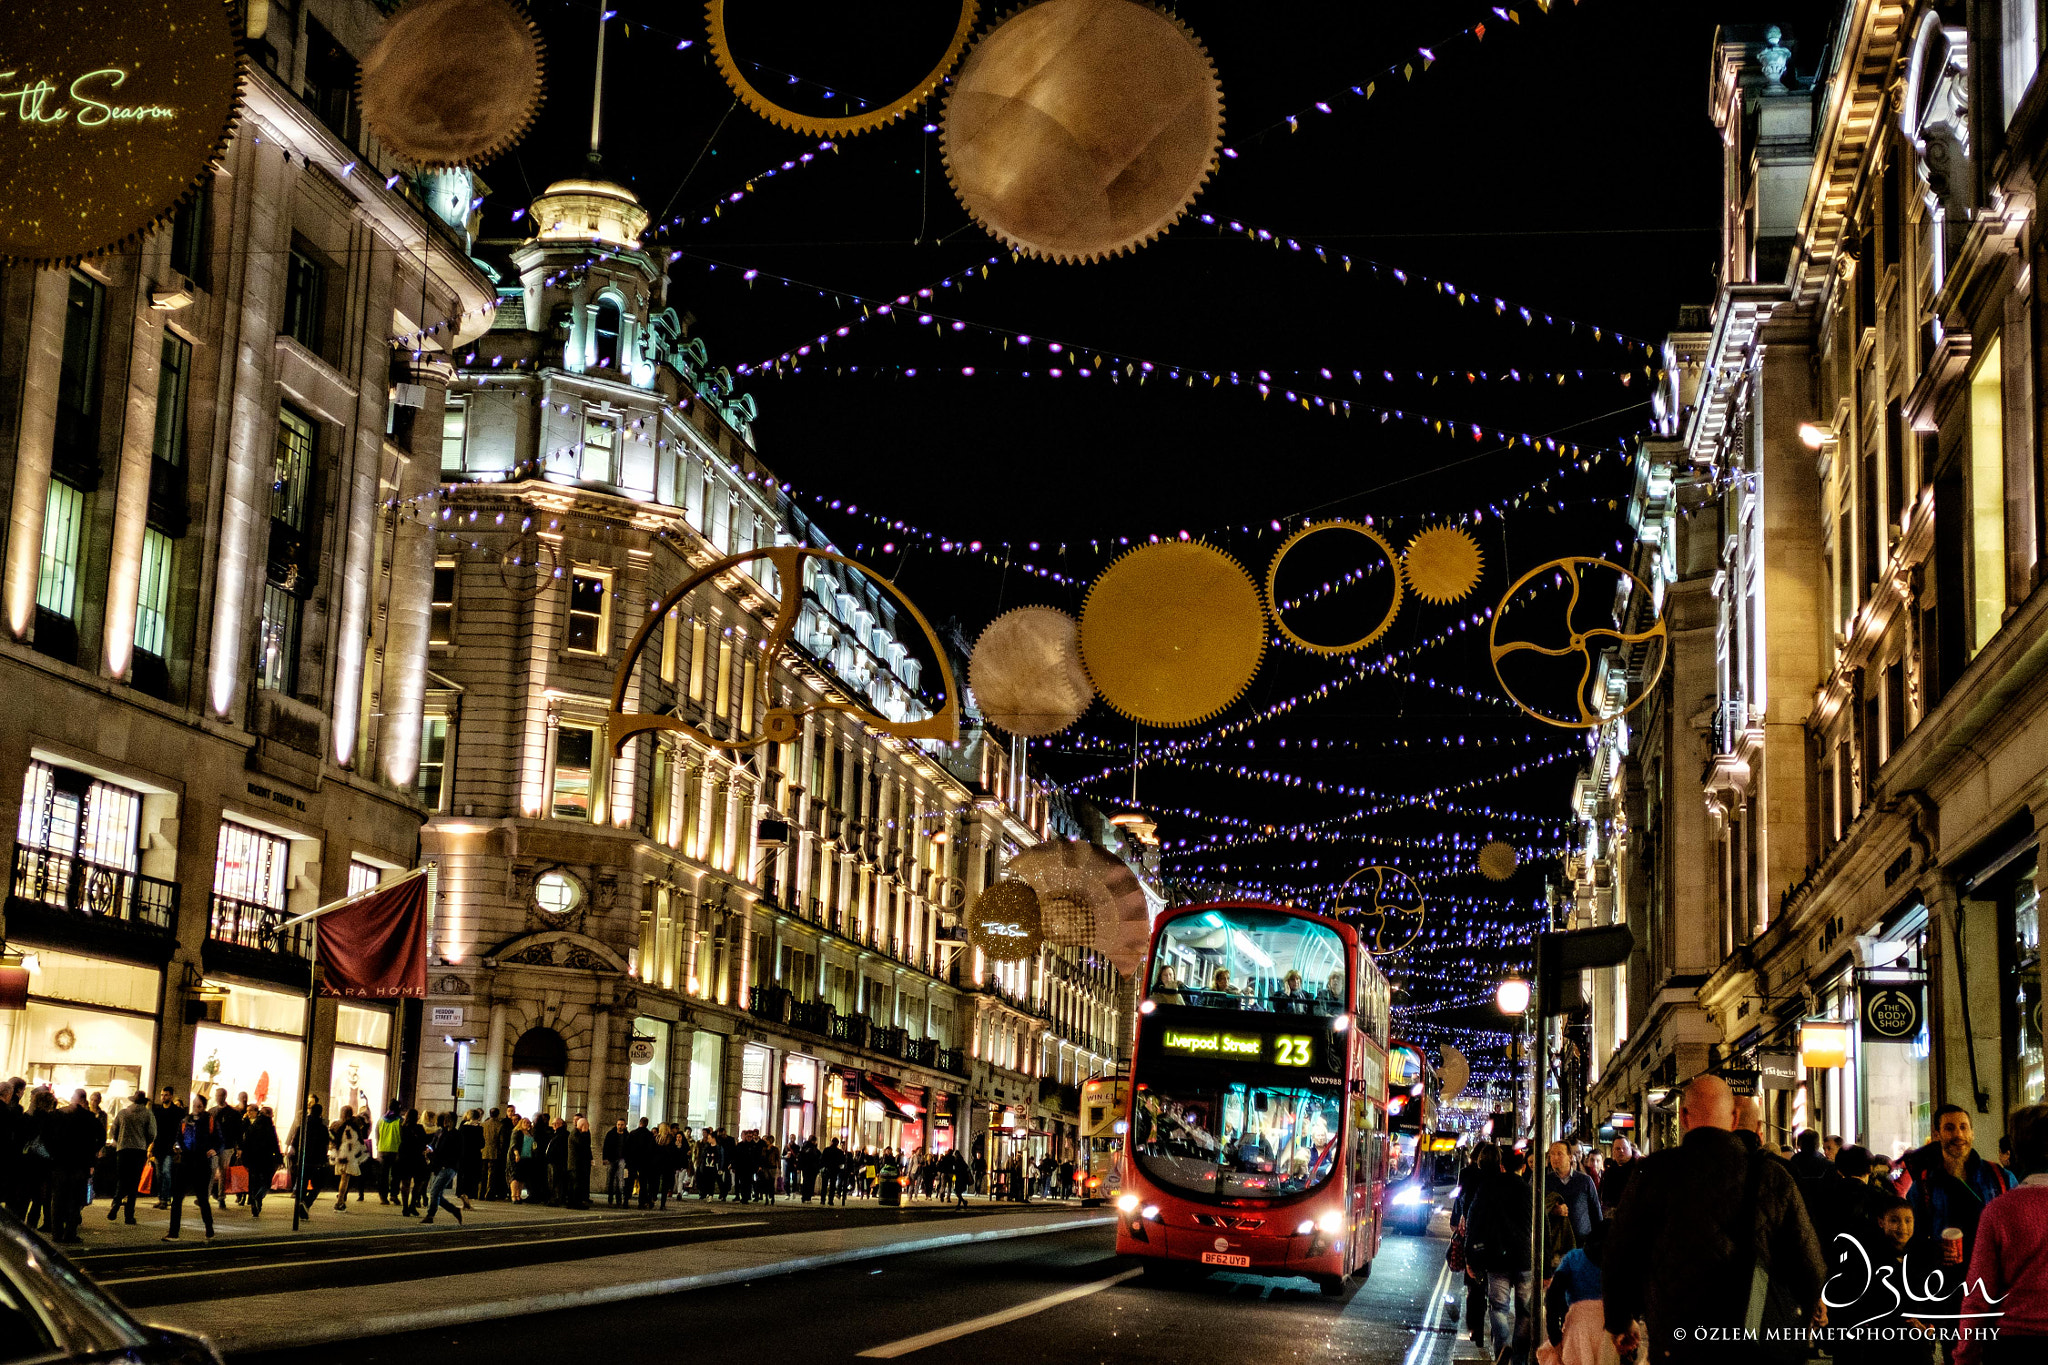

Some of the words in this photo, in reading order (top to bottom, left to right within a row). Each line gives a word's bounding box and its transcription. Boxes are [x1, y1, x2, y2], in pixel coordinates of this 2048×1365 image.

[19, 80, 70, 122] the
[70, 69, 174, 126] Season
[272, 791, 294, 807] STREET
[319, 986, 367, 996] ZARA
[376, 986, 425, 996] HOME
[1883, 1004, 1900, 1012] THE
[1877, 1011, 1907, 1020] BODY
[1879, 1019, 1906, 1028] SHOP
[1166, 1032, 1219, 1053] Liverpool
[1222, 1037, 1260, 1054] Street
[1276, 1038, 1311, 1066] 23
[630, 1050, 652, 1059] HSBC
[1309, 1076, 1342, 1086] VN37988
[1725, 1076, 1752, 1086] Russell
[1730, 1085, 1755, 1094] romley
[1086, 1093, 1103, 1102] WIN
[1205, 1253, 1228, 1264] BF62
[1229, 1256, 1247, 1266] UYB
